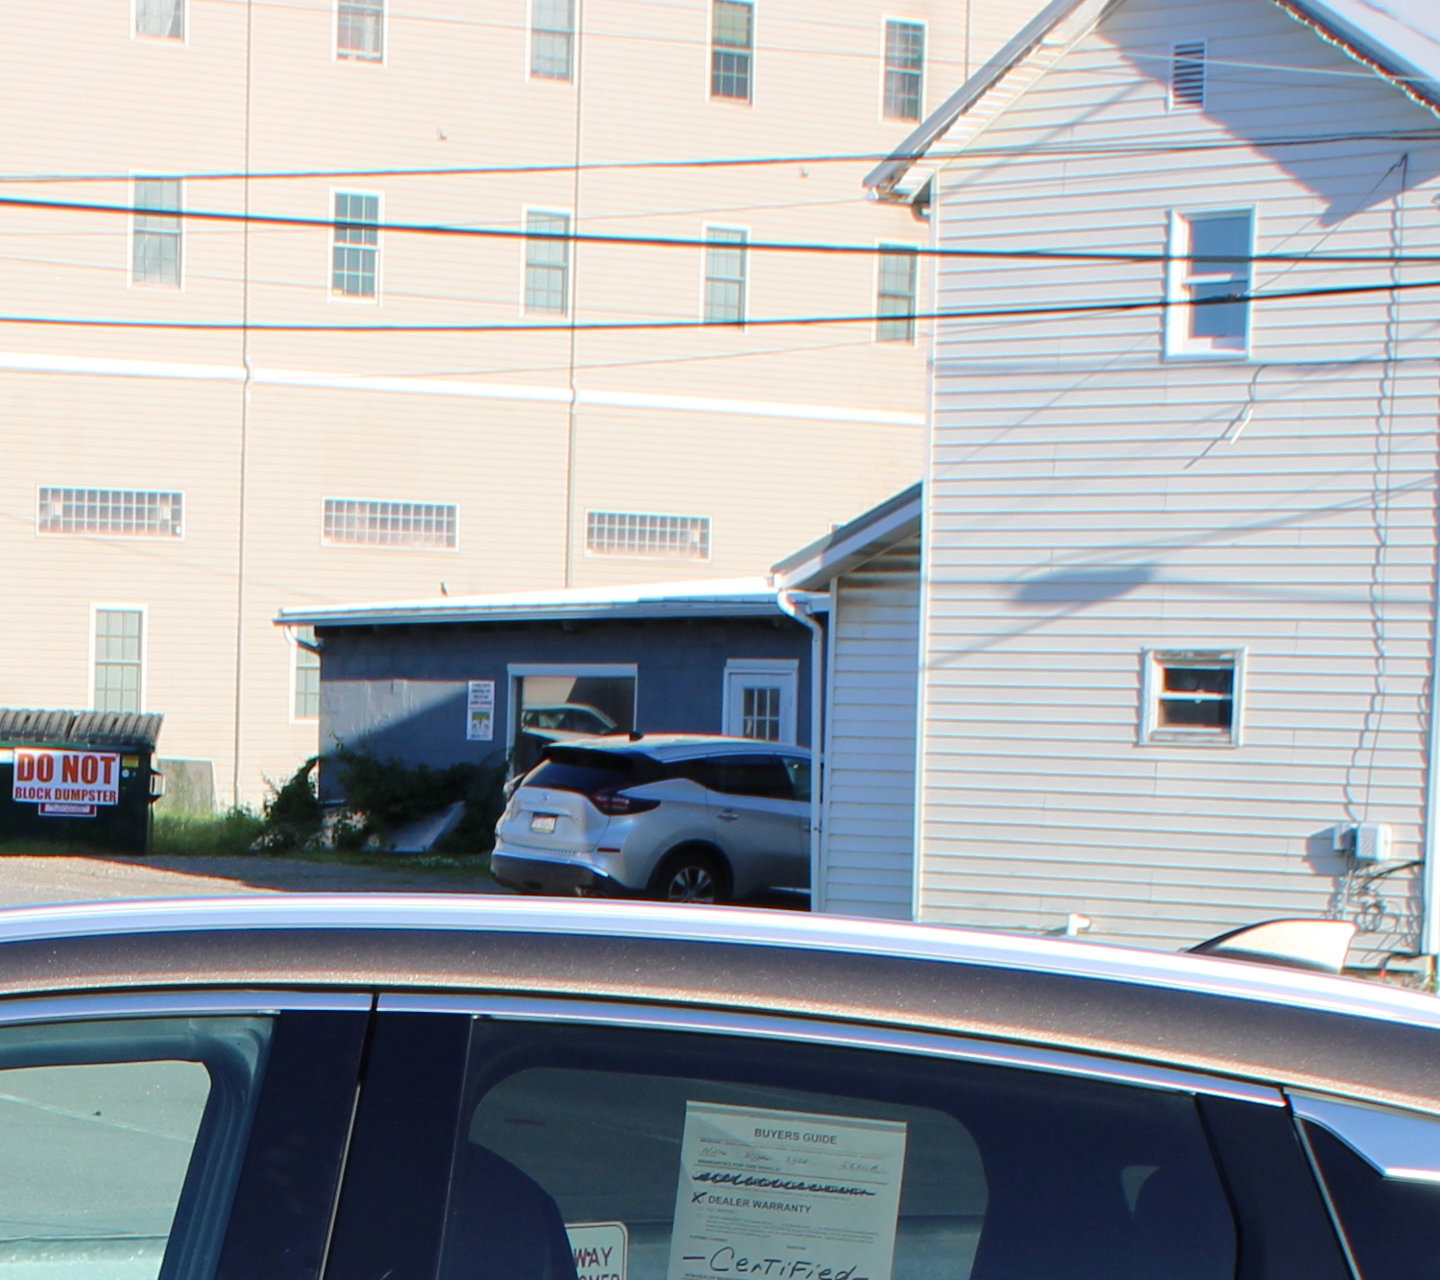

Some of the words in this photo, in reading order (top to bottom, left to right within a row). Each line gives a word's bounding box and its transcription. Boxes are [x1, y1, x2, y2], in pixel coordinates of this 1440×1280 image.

[16, 753, 54, 782] DO
[62, 754, 116, 785] NOT
[15, 787, 51, 800] BLOCK
[54, 789, 116, 803] DUMPSTER
[754, 1128, 800, 1142] BUYERS
[803, 1133, 838, 1145] GUIDE
[708, 1195, 750, 1209] DEALER
[752, 1200, 812, 1214] WARRANTY
